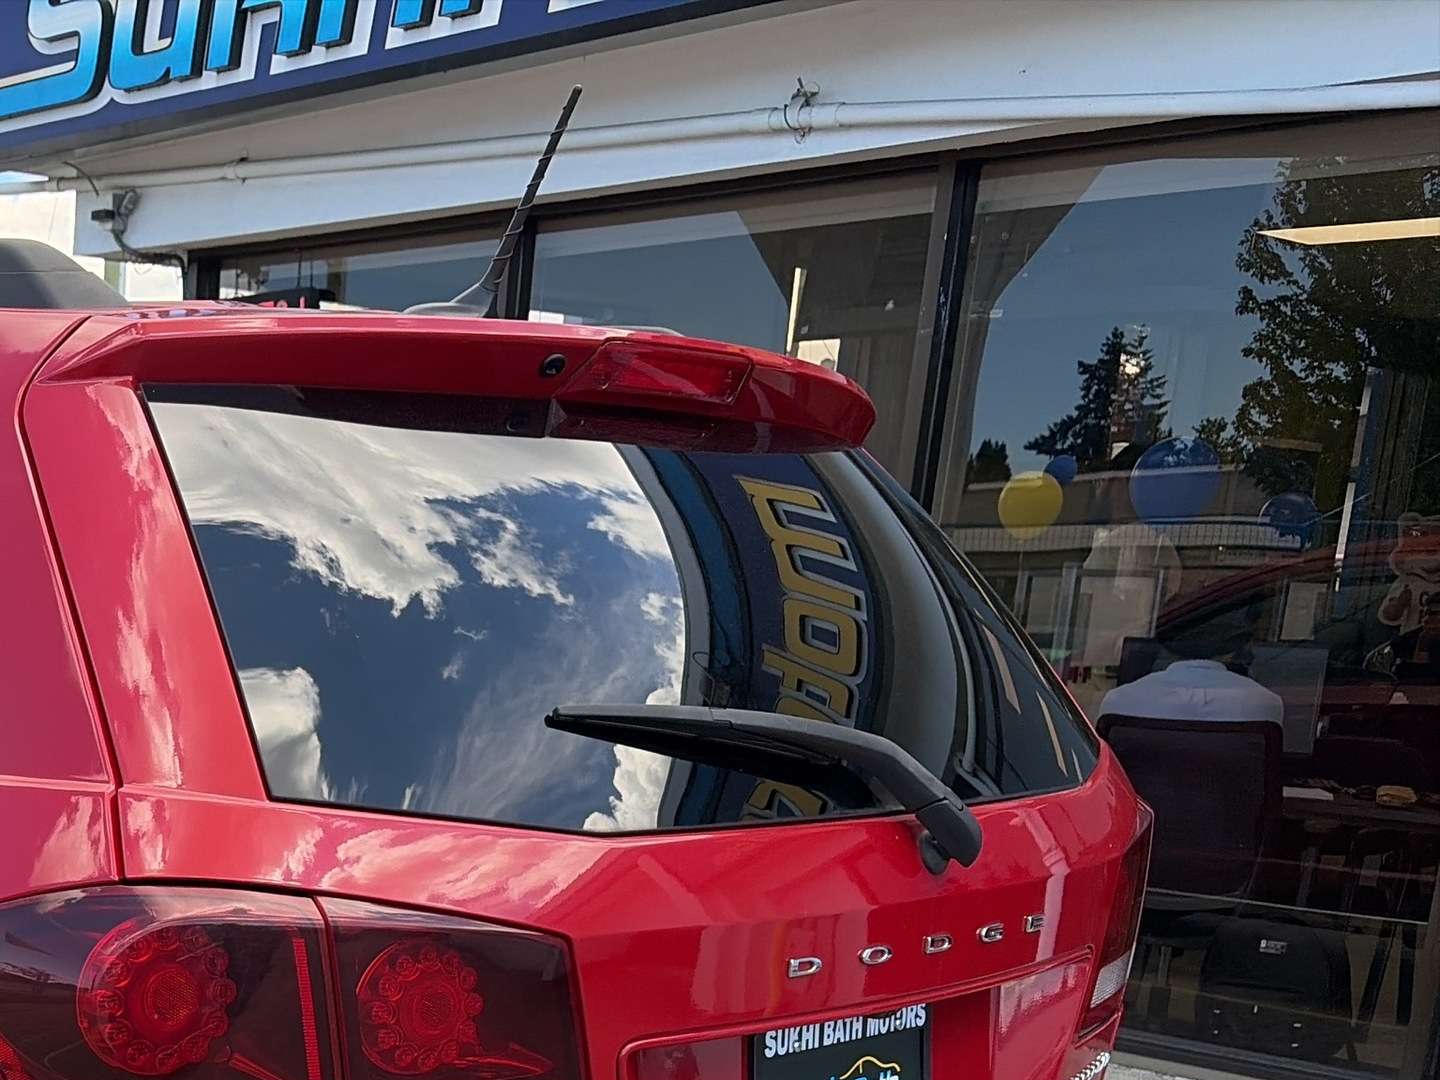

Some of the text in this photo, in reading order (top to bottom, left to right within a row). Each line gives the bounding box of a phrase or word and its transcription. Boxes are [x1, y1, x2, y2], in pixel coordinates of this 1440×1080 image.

[788, 912, 1045, 979] DODGE
[764, 1023, 820, 1058] SUKHI
[823, 1016, 863, 1046] BATH
